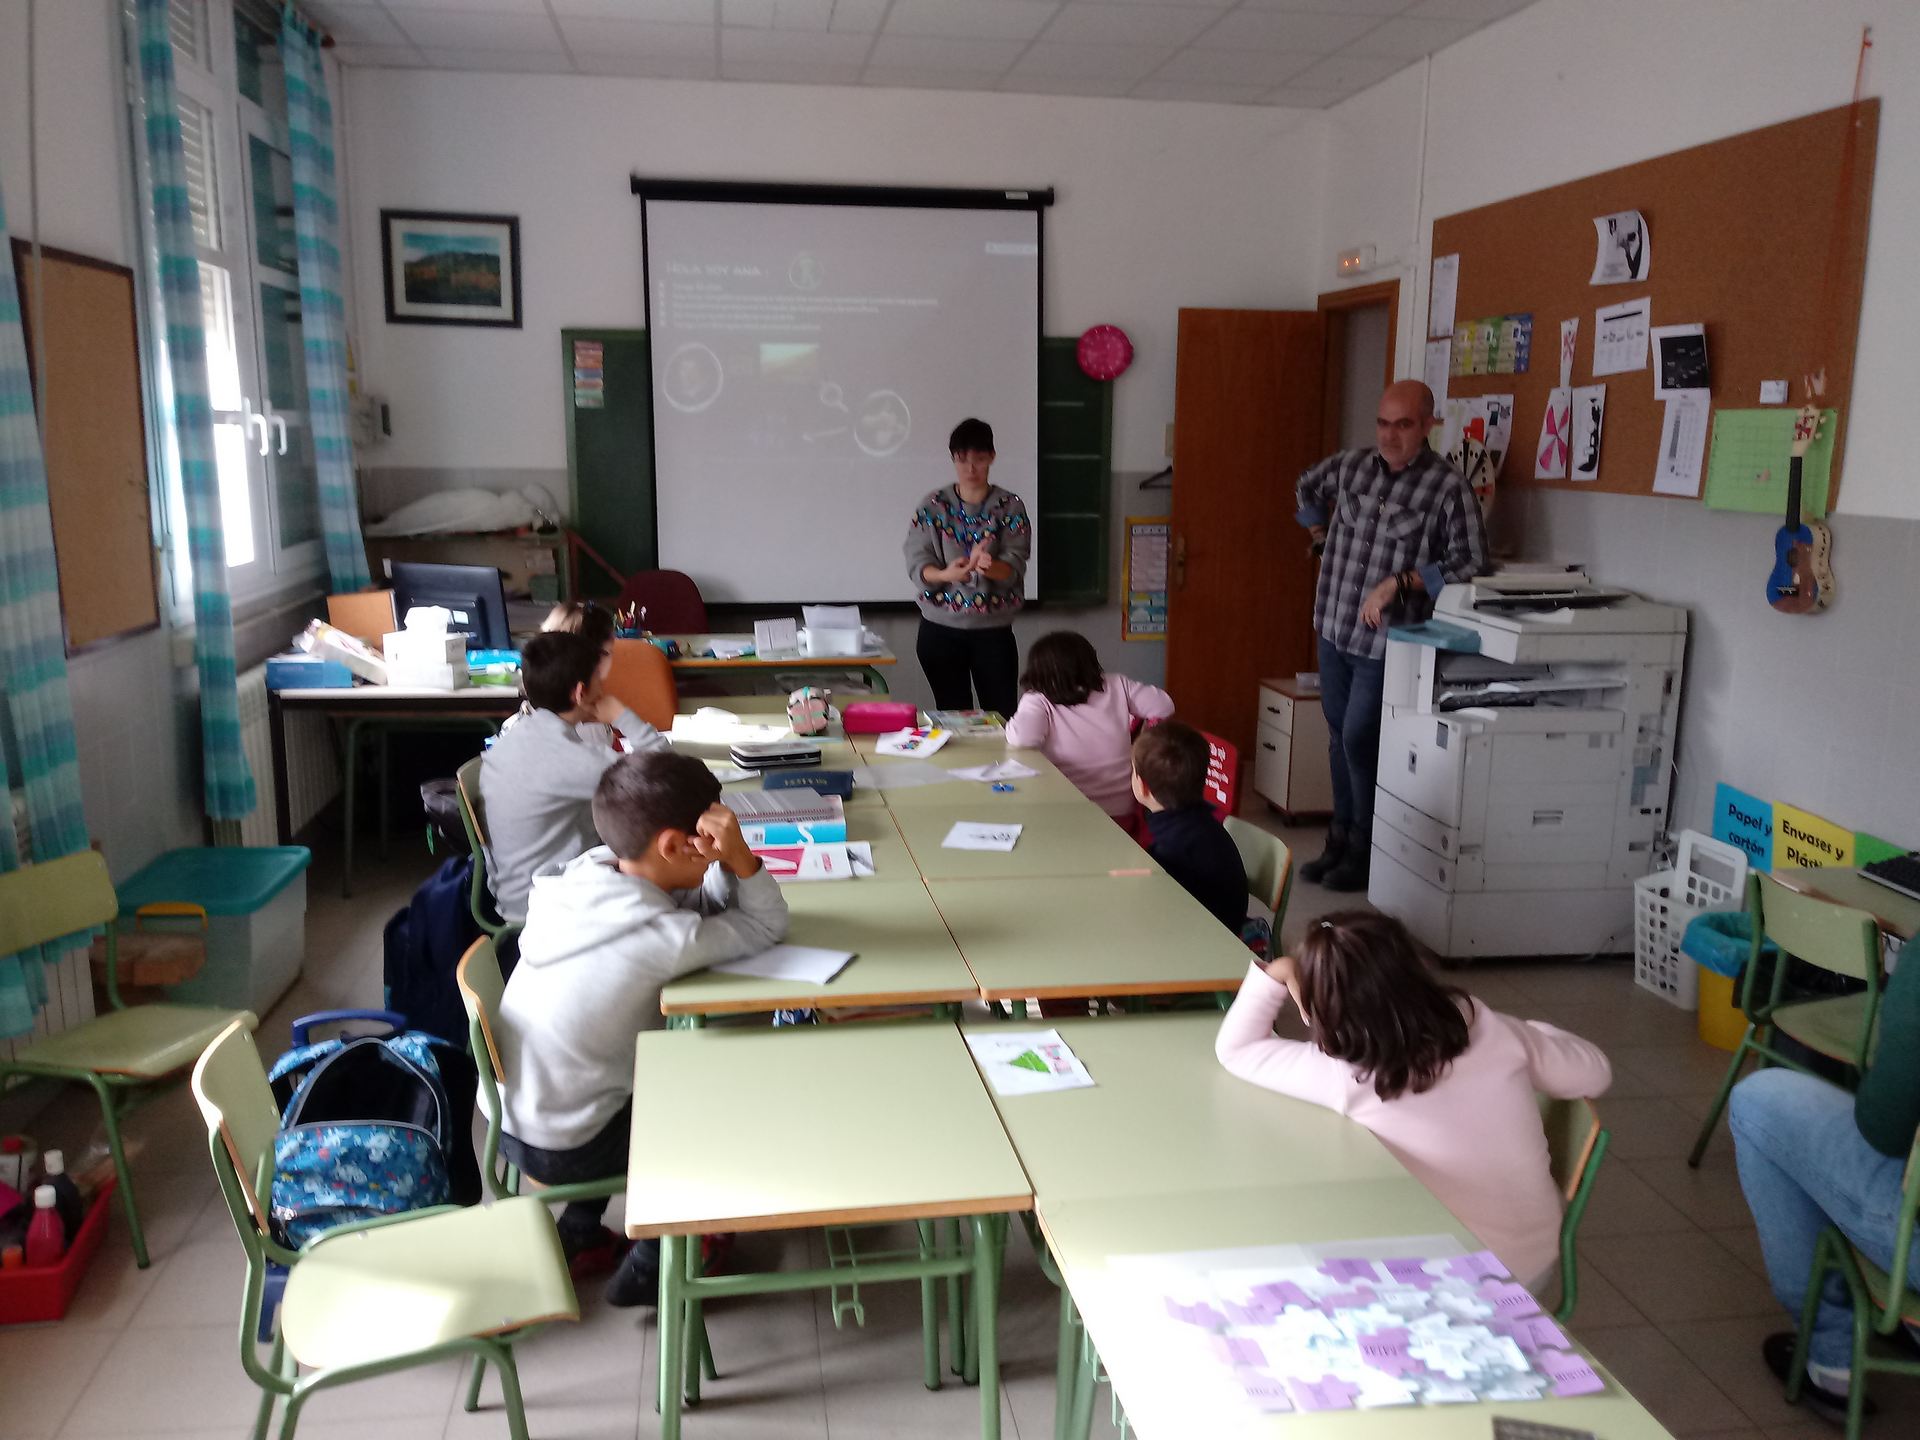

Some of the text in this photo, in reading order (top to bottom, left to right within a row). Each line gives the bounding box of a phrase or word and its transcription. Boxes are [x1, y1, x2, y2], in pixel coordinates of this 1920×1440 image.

[1728, 803, 1773, 836] Papel y
[1728, 831, 1765, 857] cartón
[1782, 819, 1844, 861] Envases y
